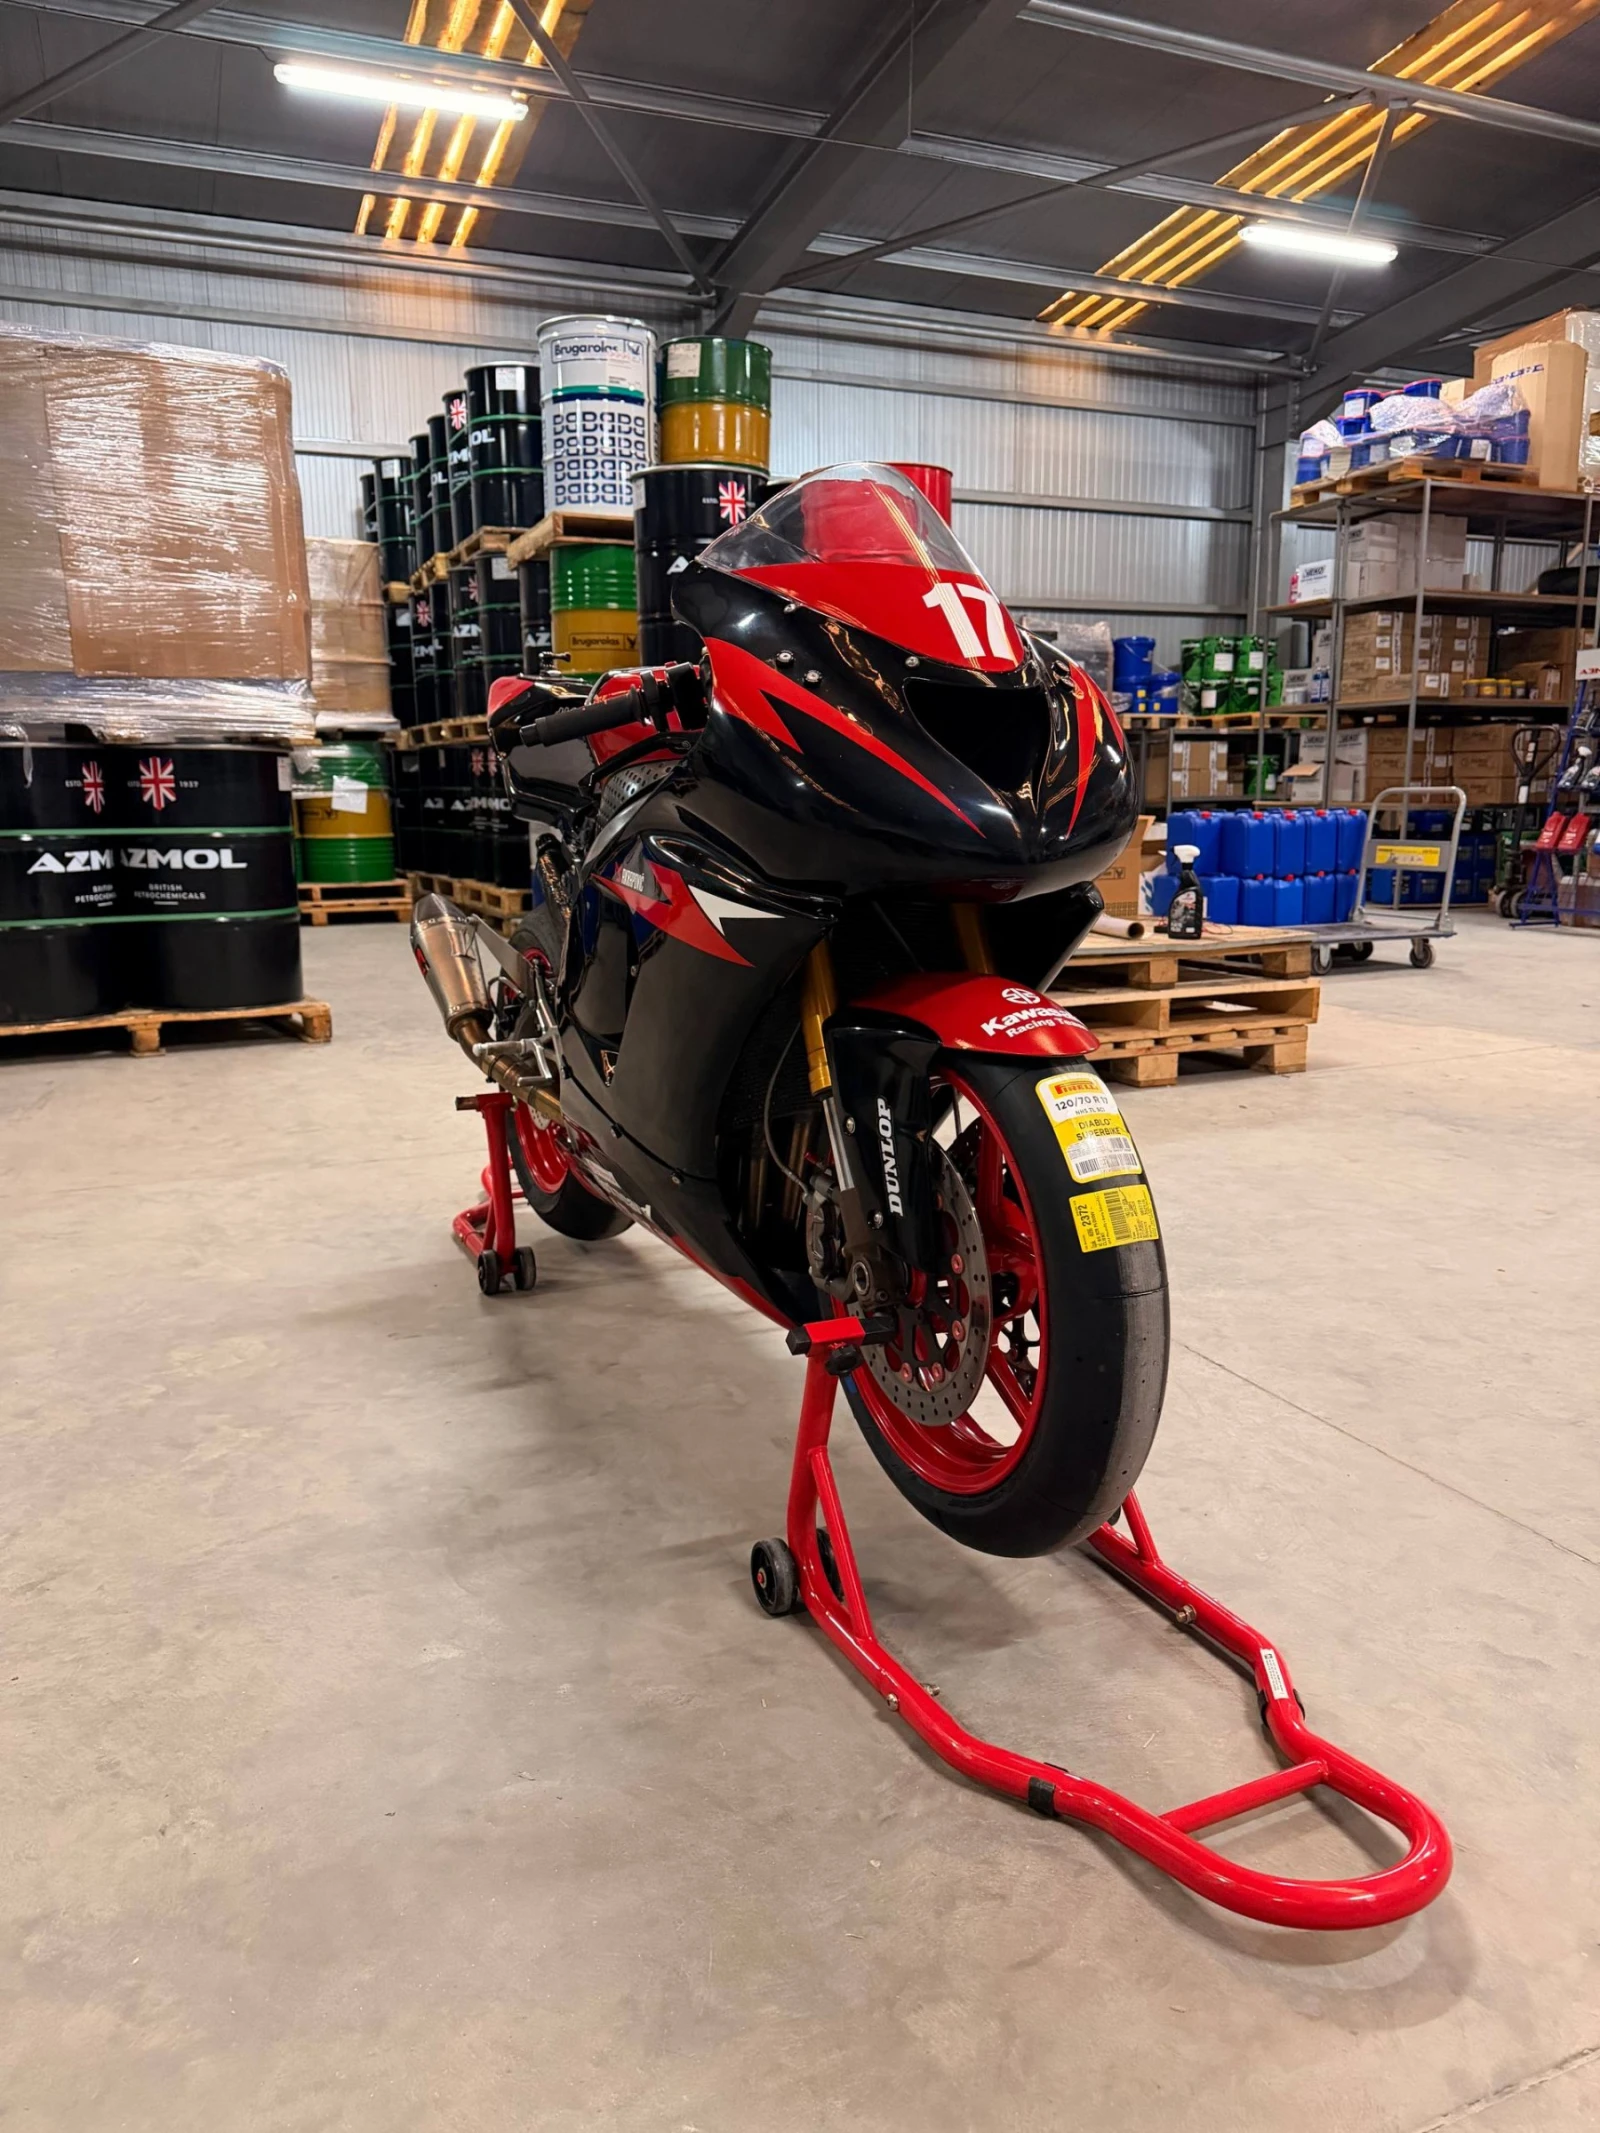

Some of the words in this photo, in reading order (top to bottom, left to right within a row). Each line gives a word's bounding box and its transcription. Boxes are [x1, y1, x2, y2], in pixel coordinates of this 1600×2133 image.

[922, 582, 1017, 661] 17
[148, 883, 183, 892] BRITISH
[980, 1007, 1086, 1037] Kawasa
[1005, 1018, 1056, 1038] Racing
[1055, 1095, 1092, 1111] 120/70
[1076, 1127, 1121, 1141] SUPERBIKE
[877, 1097, 904, 1217] DUNLOP
[1077, 1203, 1092, 1227] 2372
